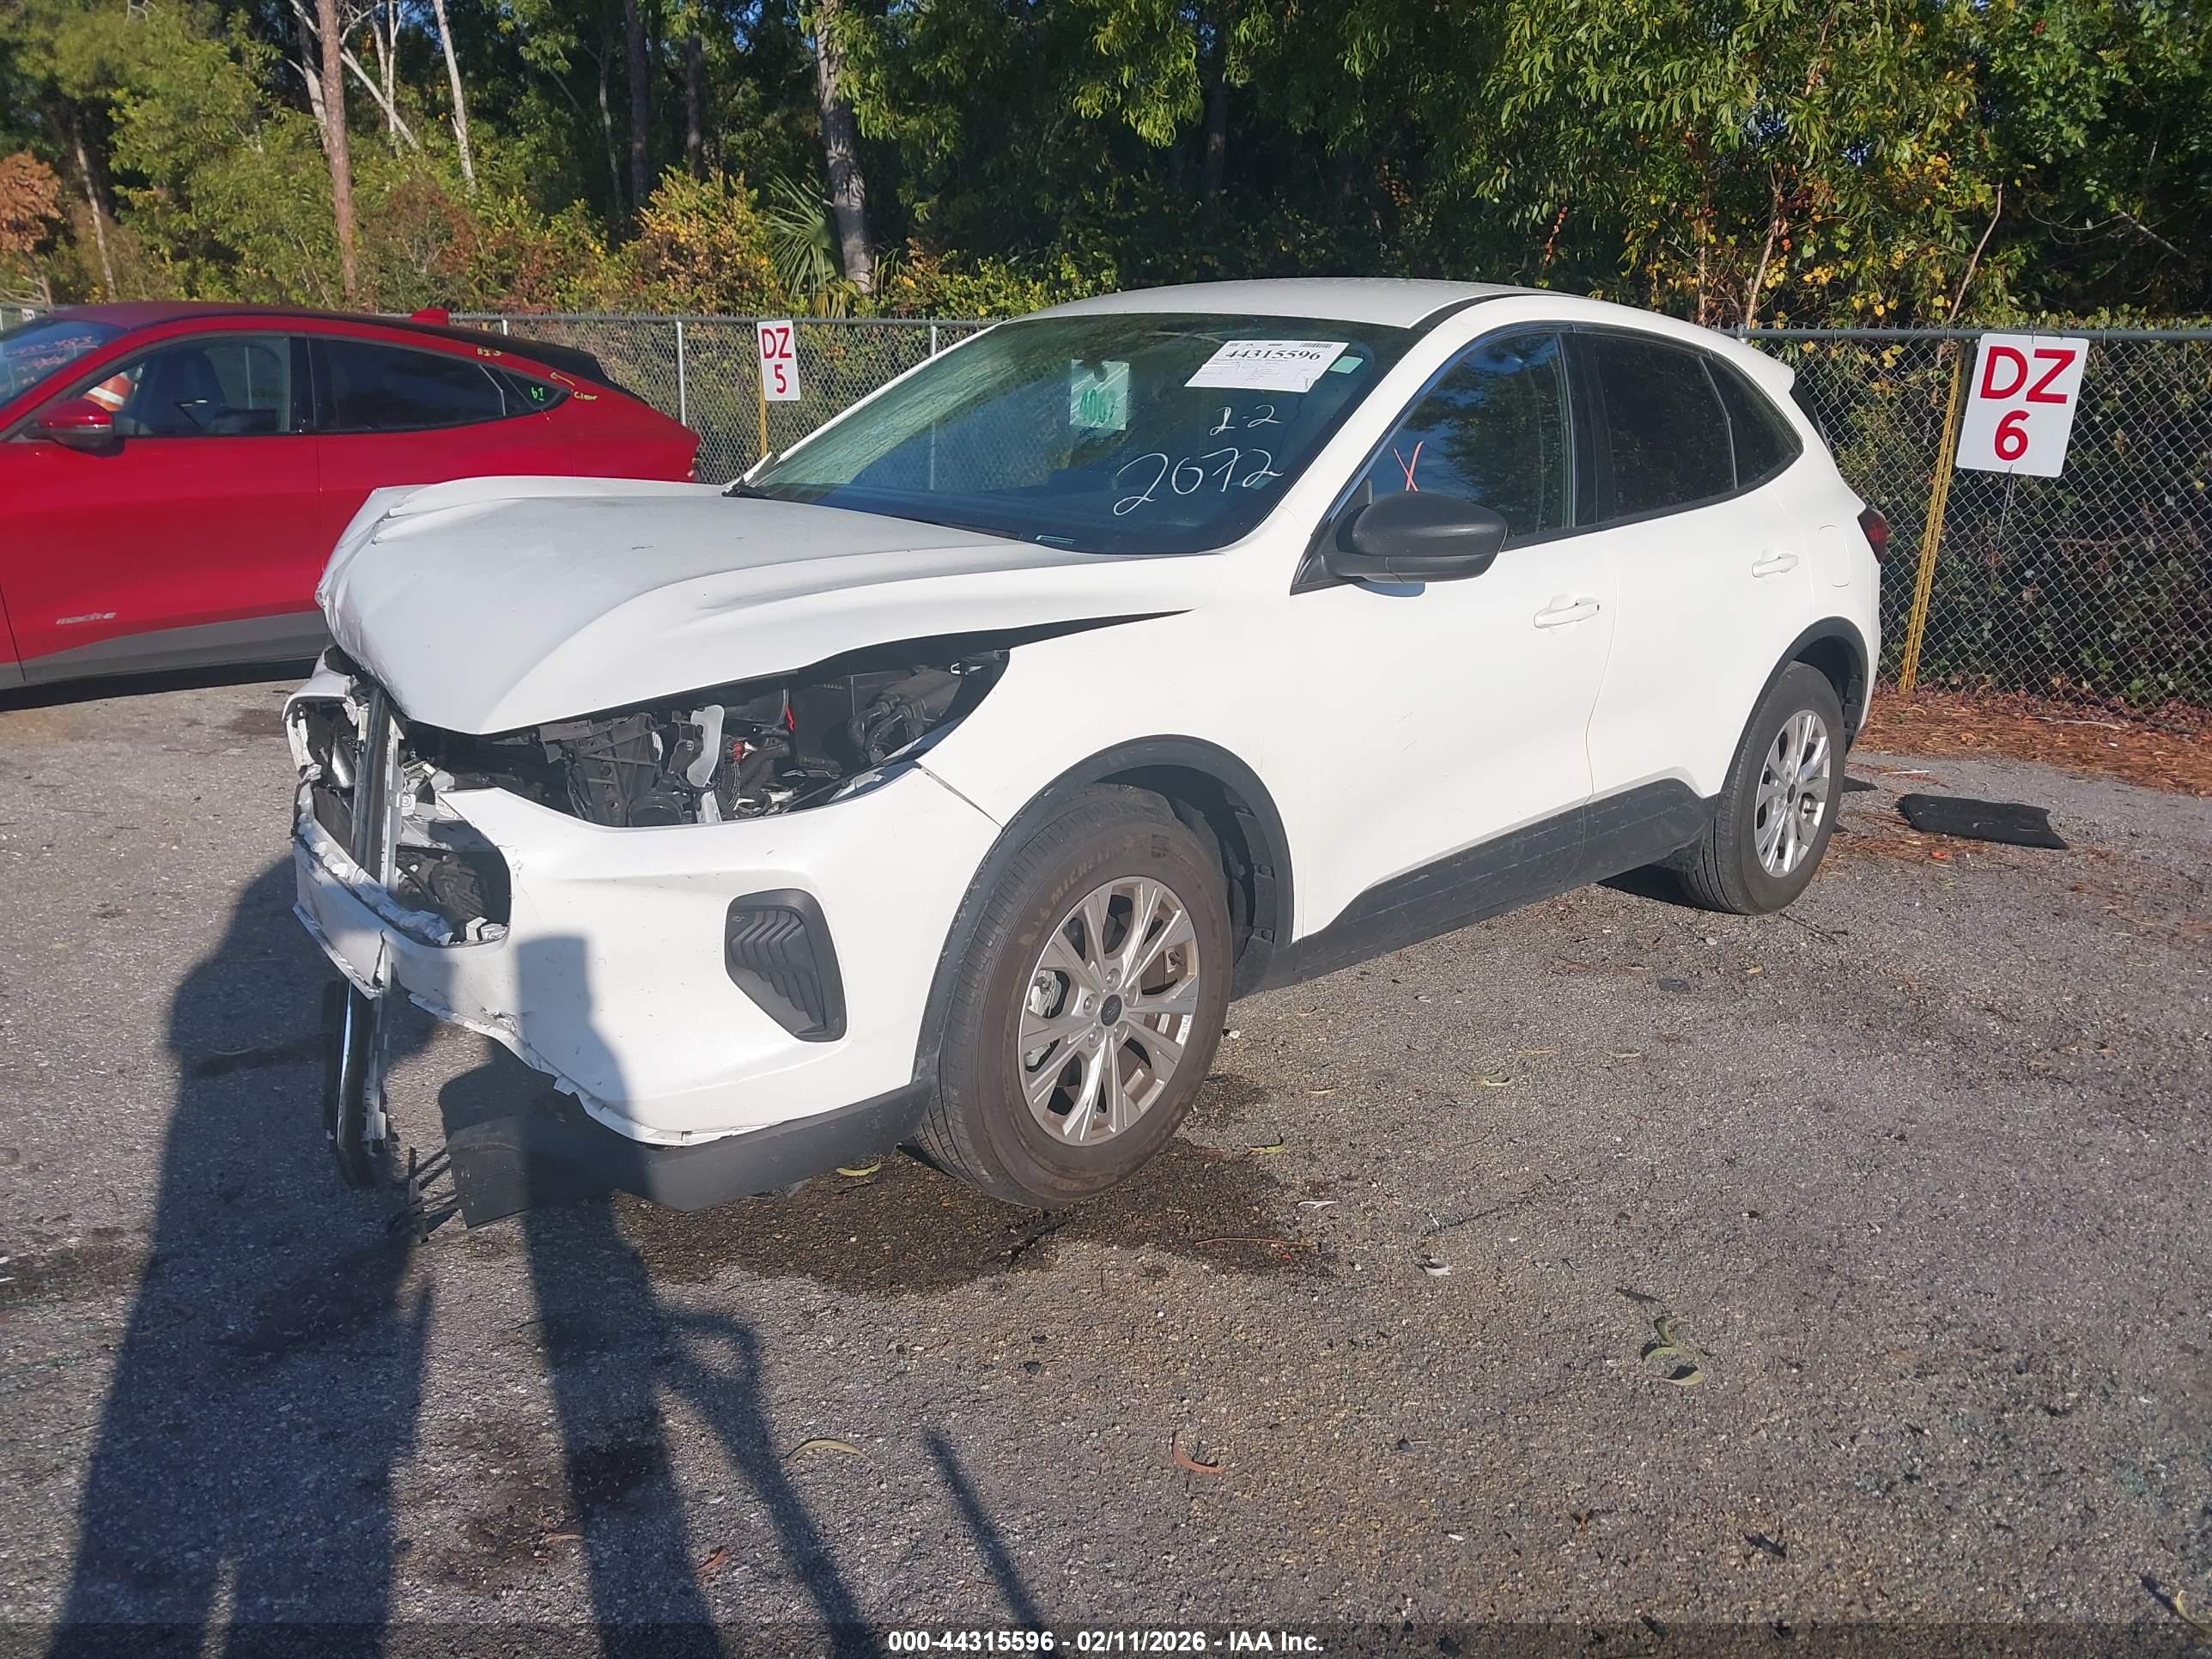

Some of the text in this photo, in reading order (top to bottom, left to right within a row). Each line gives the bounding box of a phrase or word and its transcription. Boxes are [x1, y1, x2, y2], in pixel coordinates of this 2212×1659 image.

[761, 327, 792, 359] DZ
[1225, 349, 1321, 361] 44315596
[774, 364, 787, 393] 5
[1980, 346, 2076, 404] DZ
[1994, 409, 2031, 461] 6
